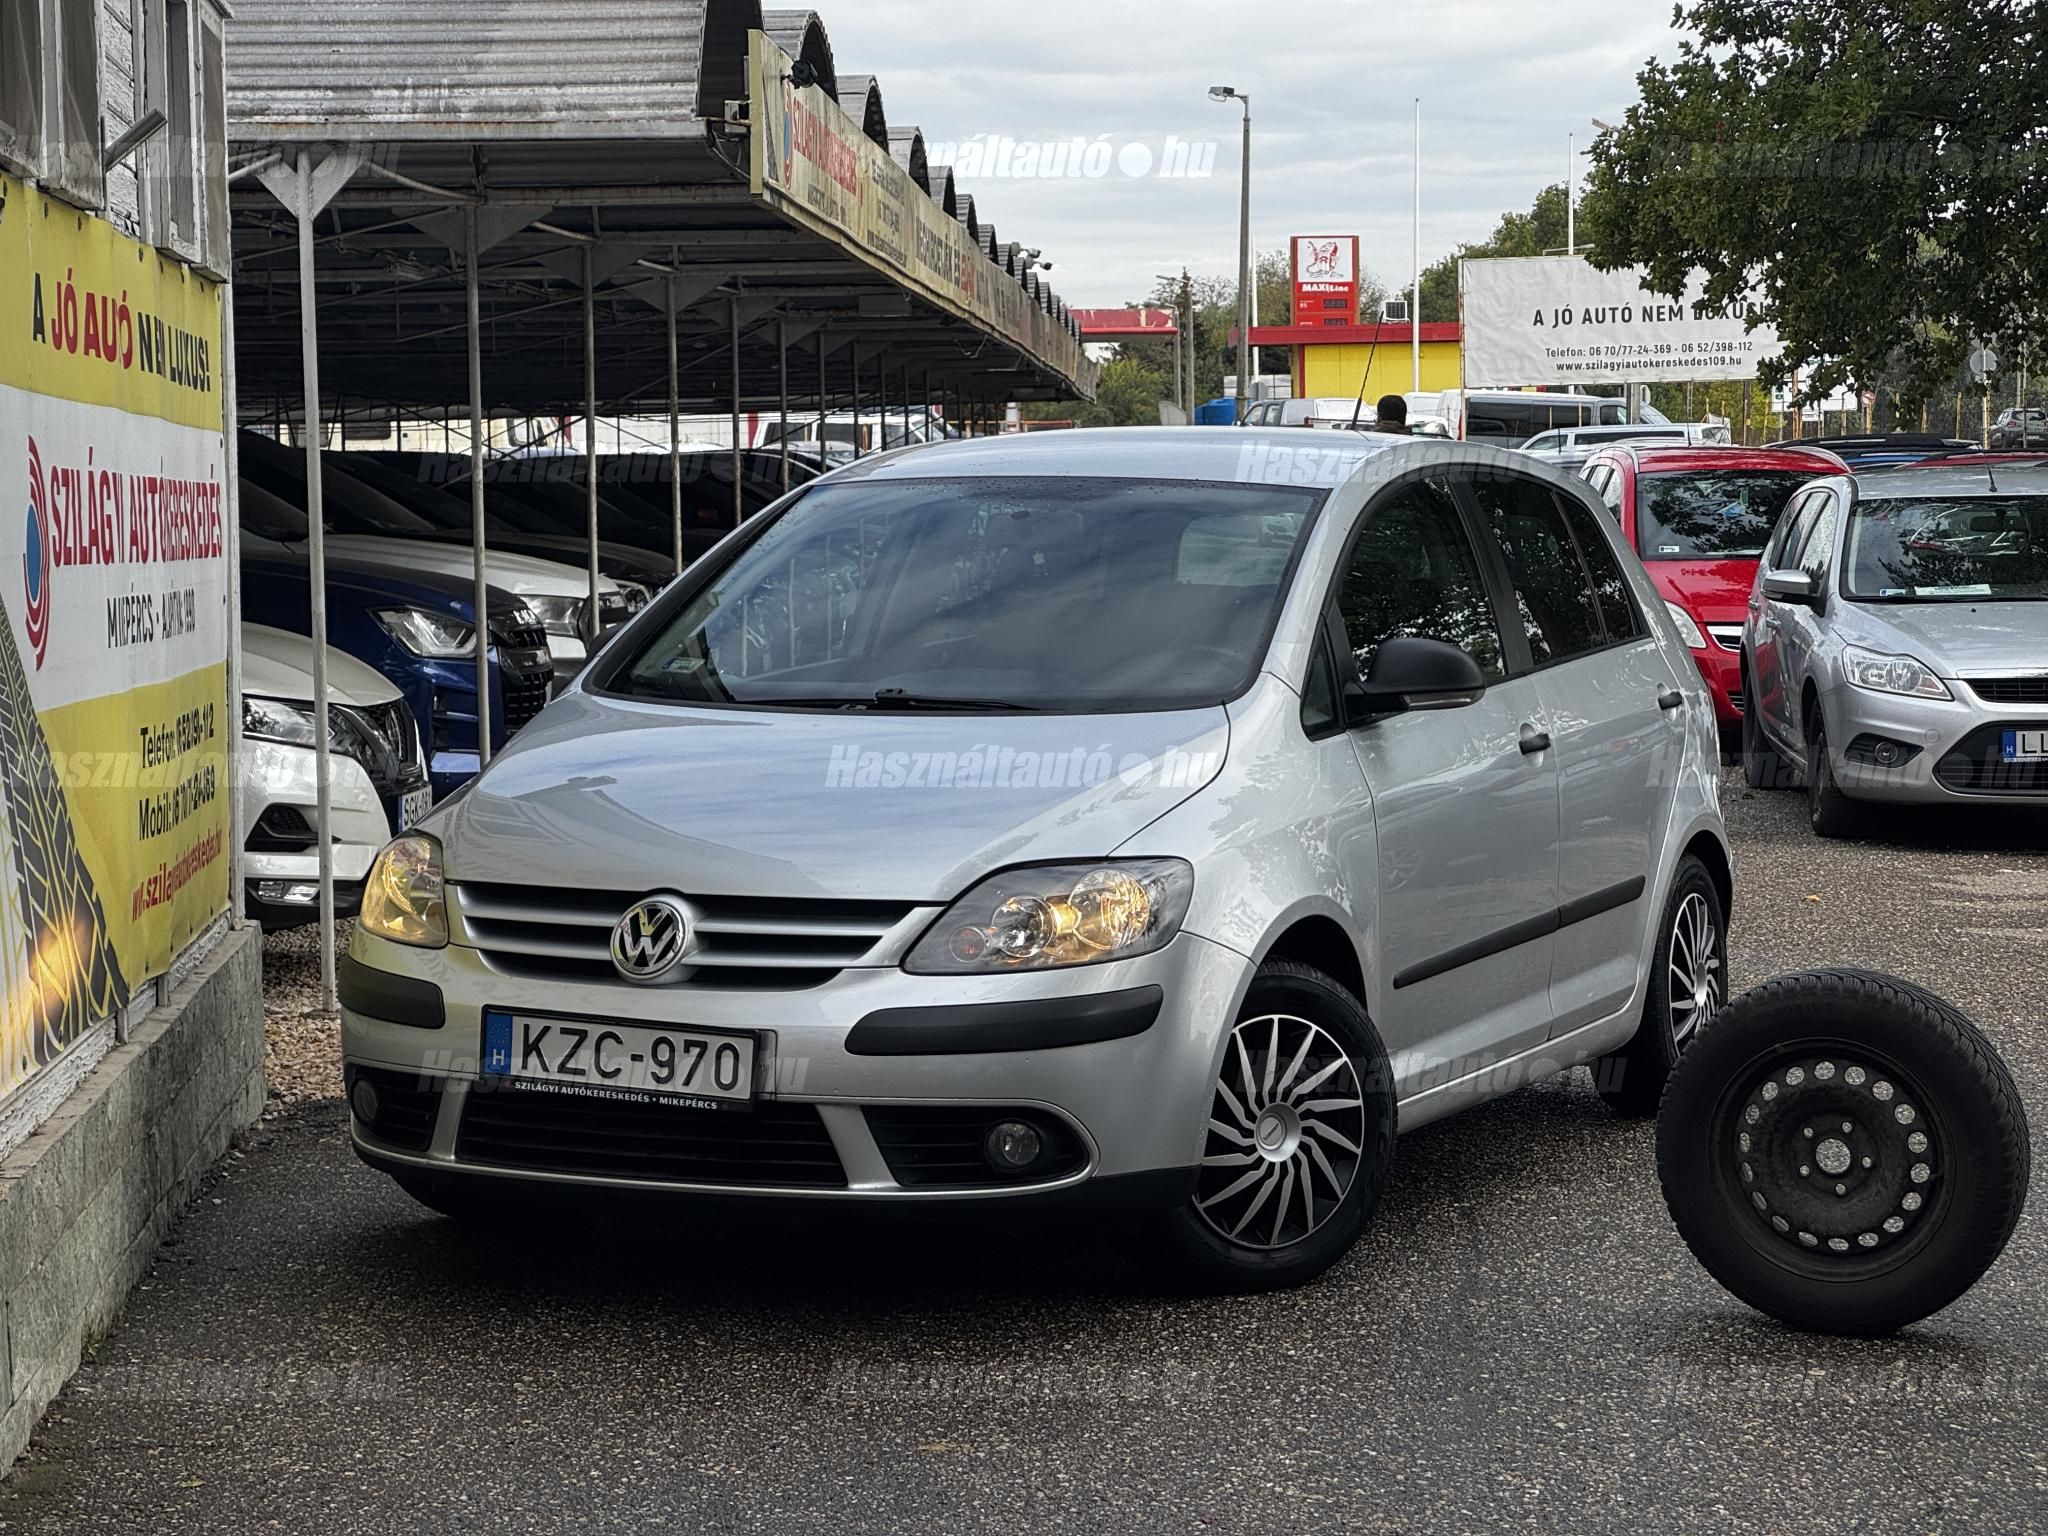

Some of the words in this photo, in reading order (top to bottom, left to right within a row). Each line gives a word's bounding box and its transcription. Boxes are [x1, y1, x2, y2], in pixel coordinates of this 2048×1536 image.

[1533, 309, 1545, 326] A
[1552, 304, 1573, 329] JÓ
[1581, 302, 1632, 325] AUTÓ
[1642, 305, 1684, 323] NEM
[33, 272, 46, 344] A
[51, 267, 78, 354] JÓ
[168, 325, 211, 392] LUXUS!
[1545, 347, 1586, 358] Telefon:
[1589, 346, 1602, 356] 06
[1604, 344, 1671, 356] 70/77-24-369
[1681, 343, 1694, 353] 06
[1697, 341, 1753, 353] 52/398-112
[1556, 355, 1742, 372] www.szilagyiautokereskedes109.hu
[493, 1048, 505, 1066] H
[521, 1023, 740, 1092] KZC-970
[514, 1081, 559, 1094] SZILÁGYI
[560, 1086, 650, 1103] AUTÓKERESKEDÉS
[659, 1095, 718, 1110] MIKEPÉRCS
